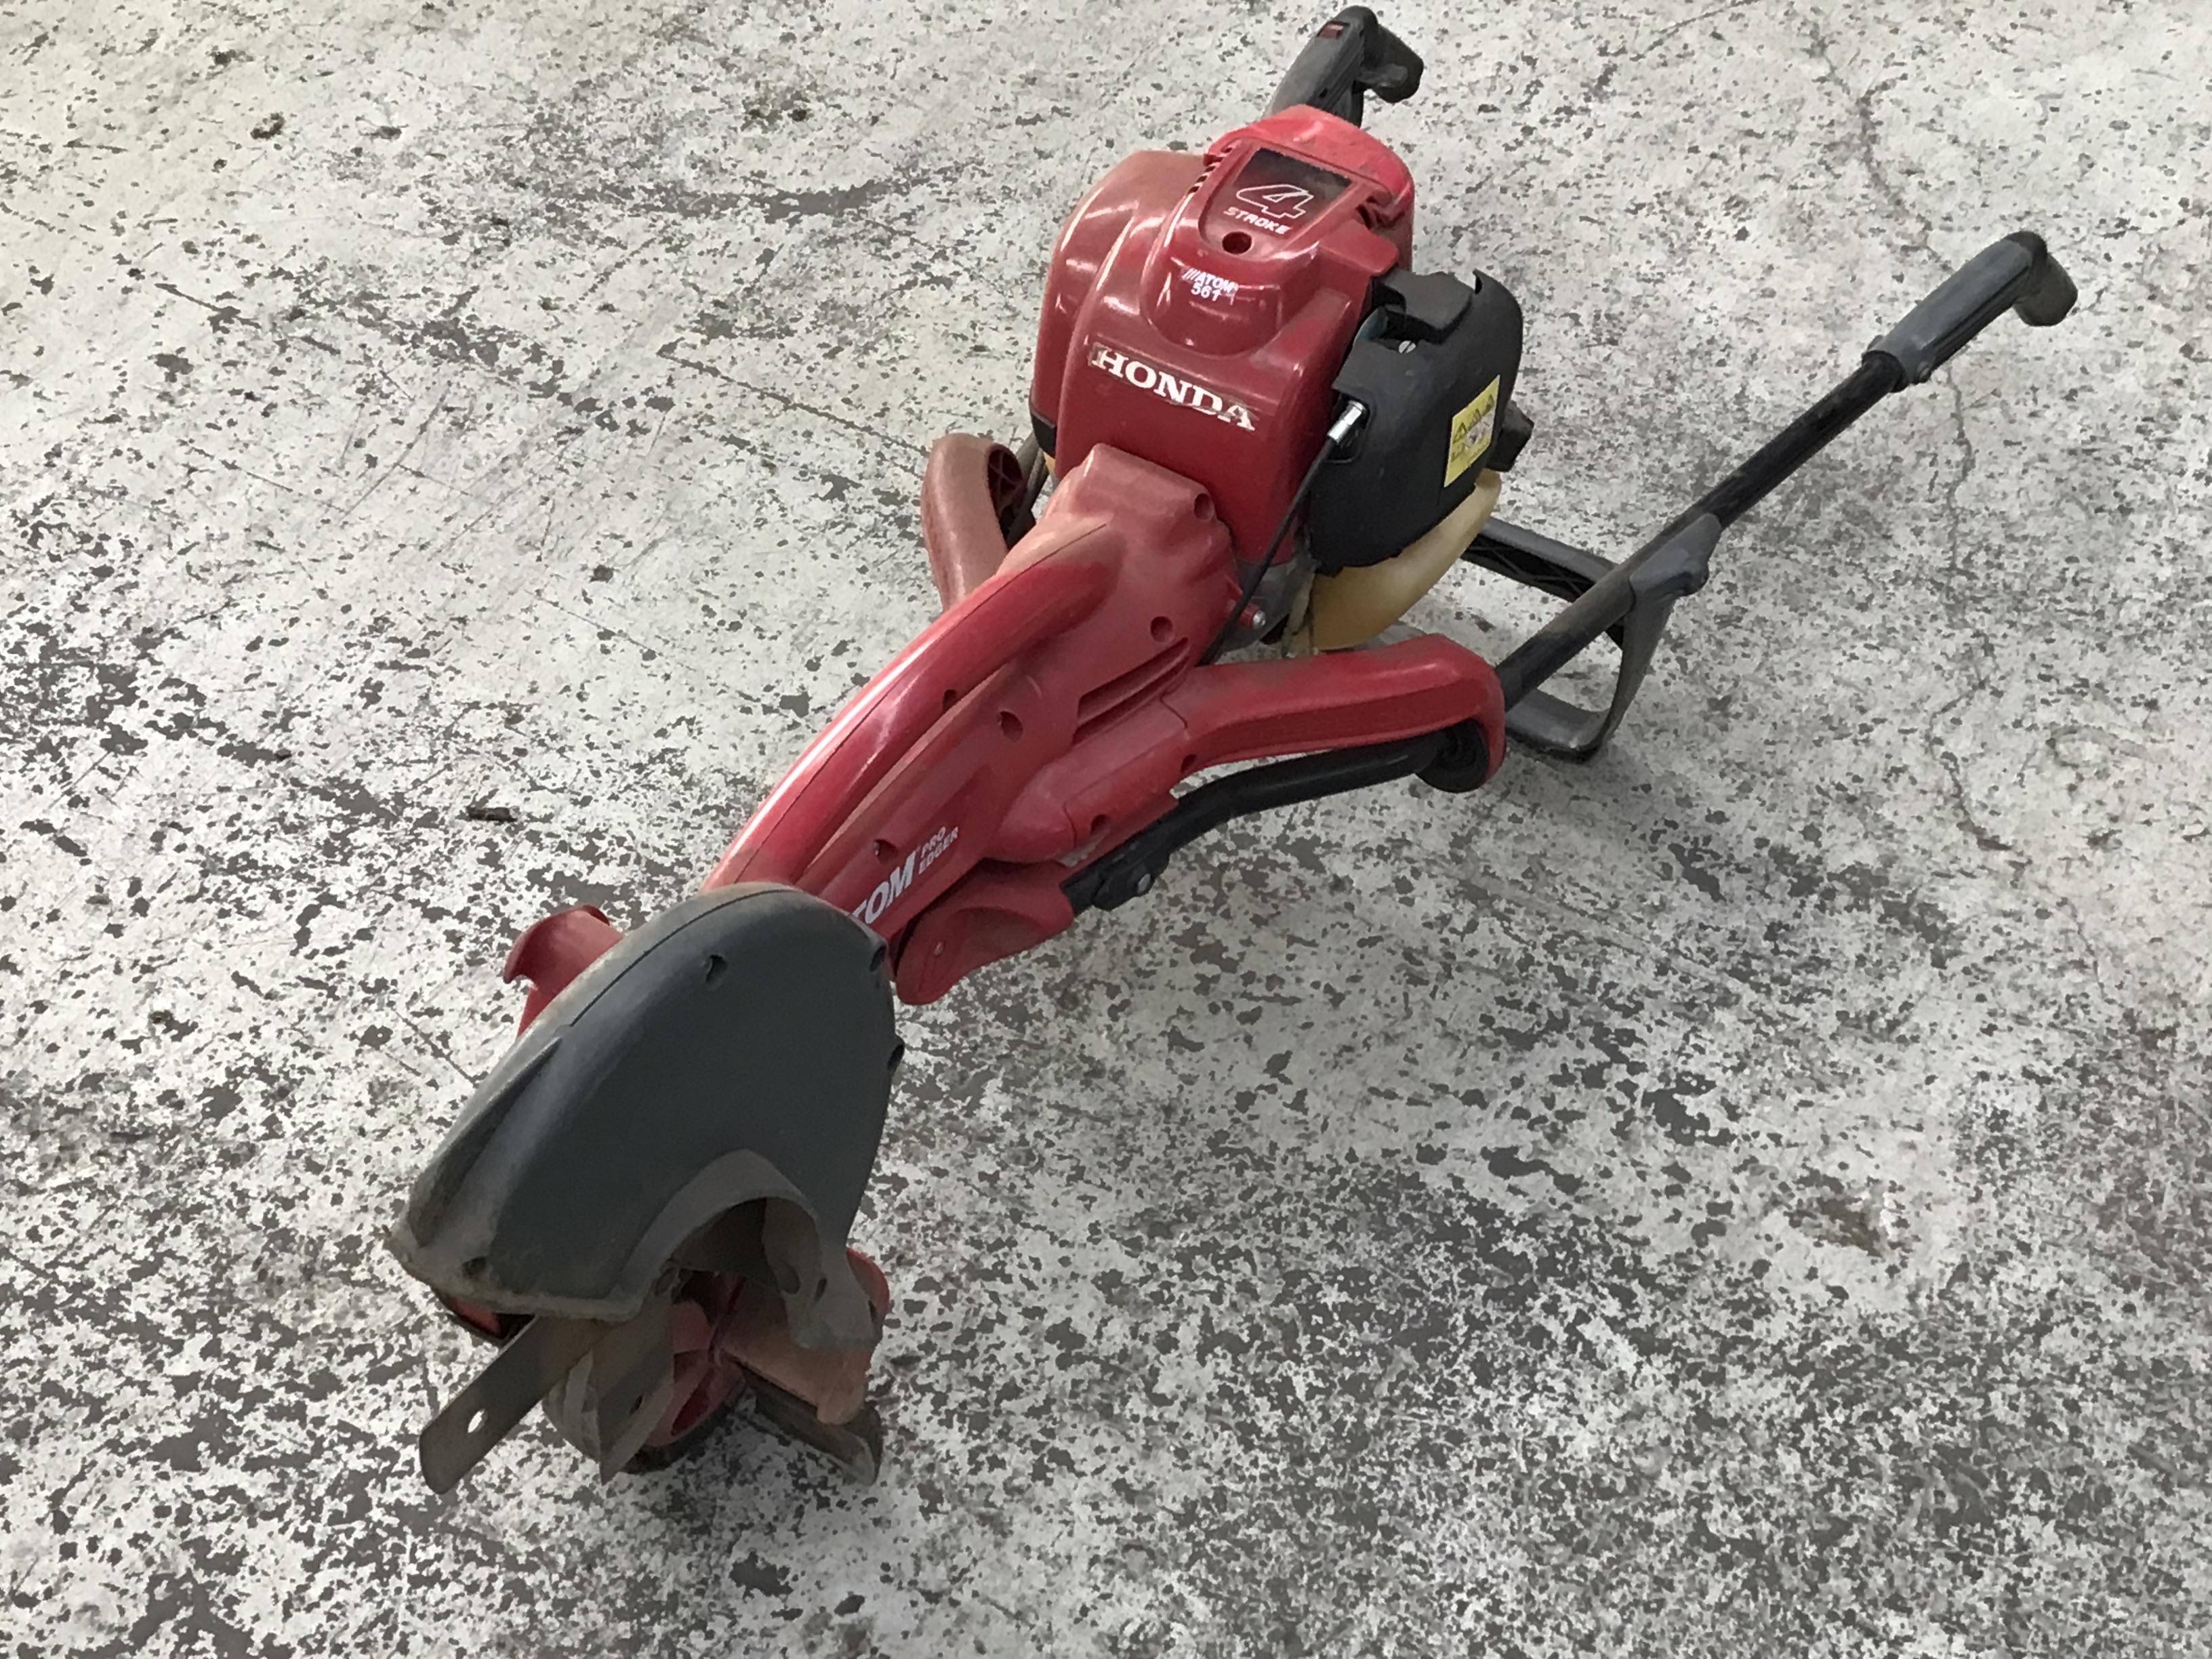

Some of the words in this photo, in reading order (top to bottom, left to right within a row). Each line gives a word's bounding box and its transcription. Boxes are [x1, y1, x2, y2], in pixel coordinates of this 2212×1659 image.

[1236, 184, 1314, 219] 4
[1223, 207, 1292, 234] STROKE
[1194, 271, 1236, 293] ATOM
[1092, 349, 1256, 432] HONDA
[918, 825, 959, 875] EDGER
[920, 825, 946, 859] PRO
